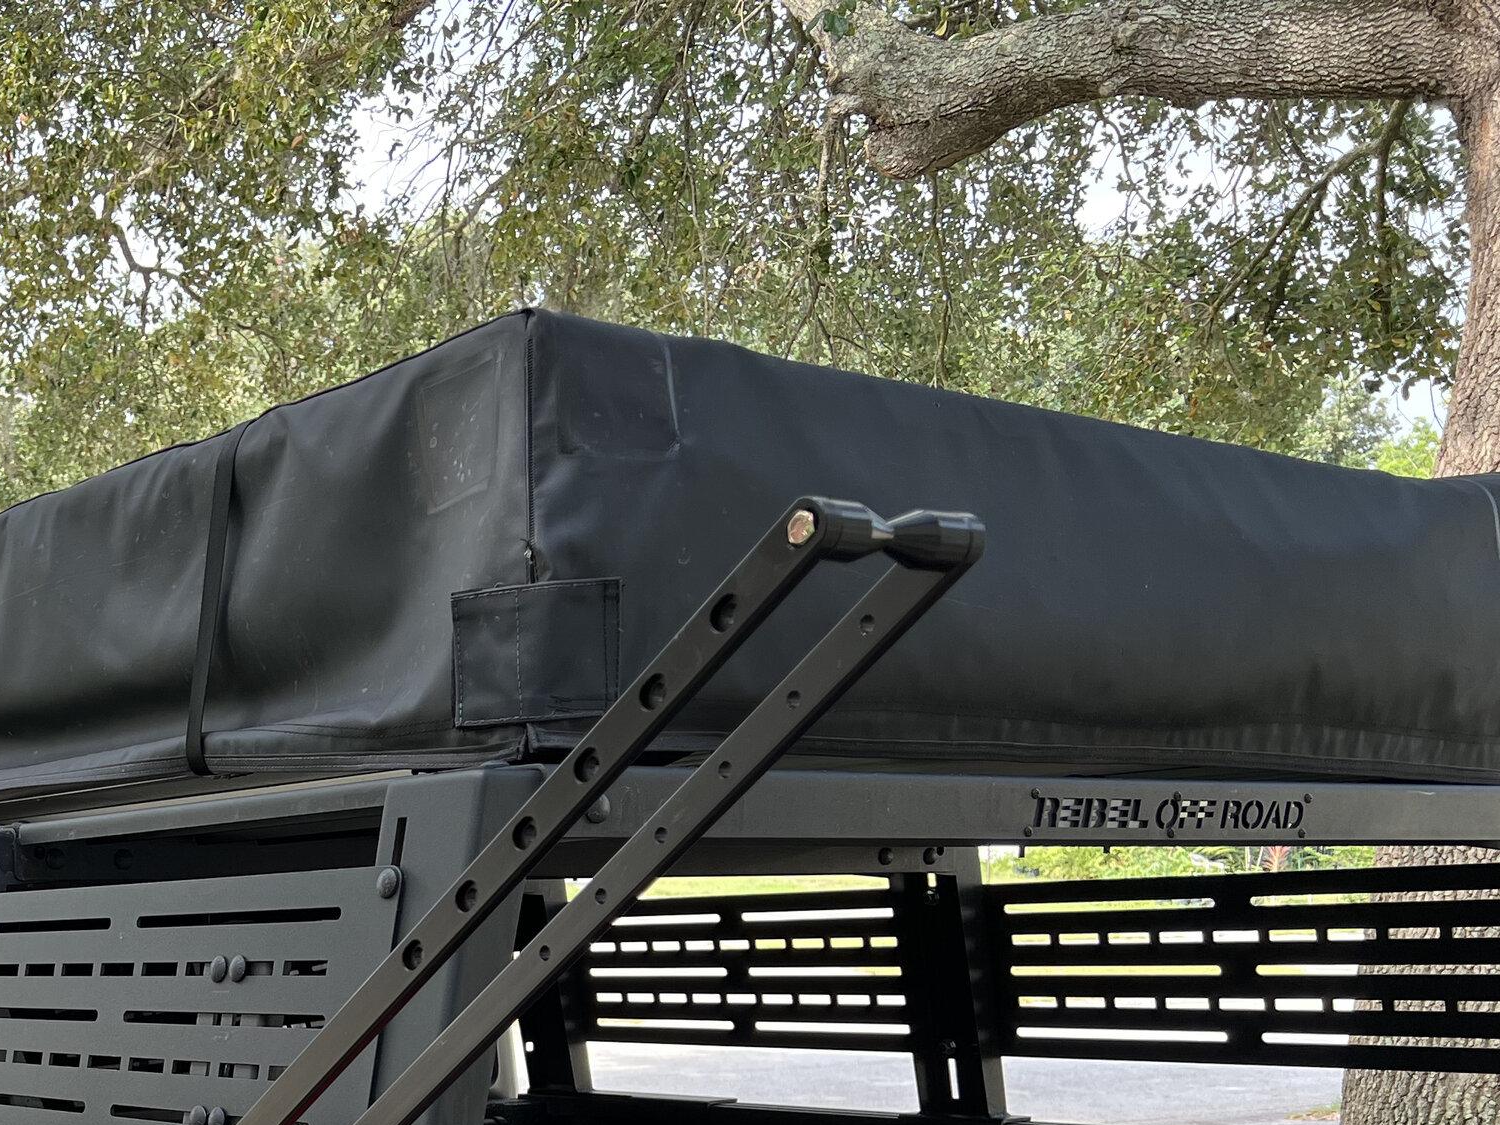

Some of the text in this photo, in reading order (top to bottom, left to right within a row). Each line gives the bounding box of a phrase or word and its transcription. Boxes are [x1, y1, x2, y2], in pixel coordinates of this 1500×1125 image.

[1033, 797, 1304, 831] REBEL OFF ROAD
